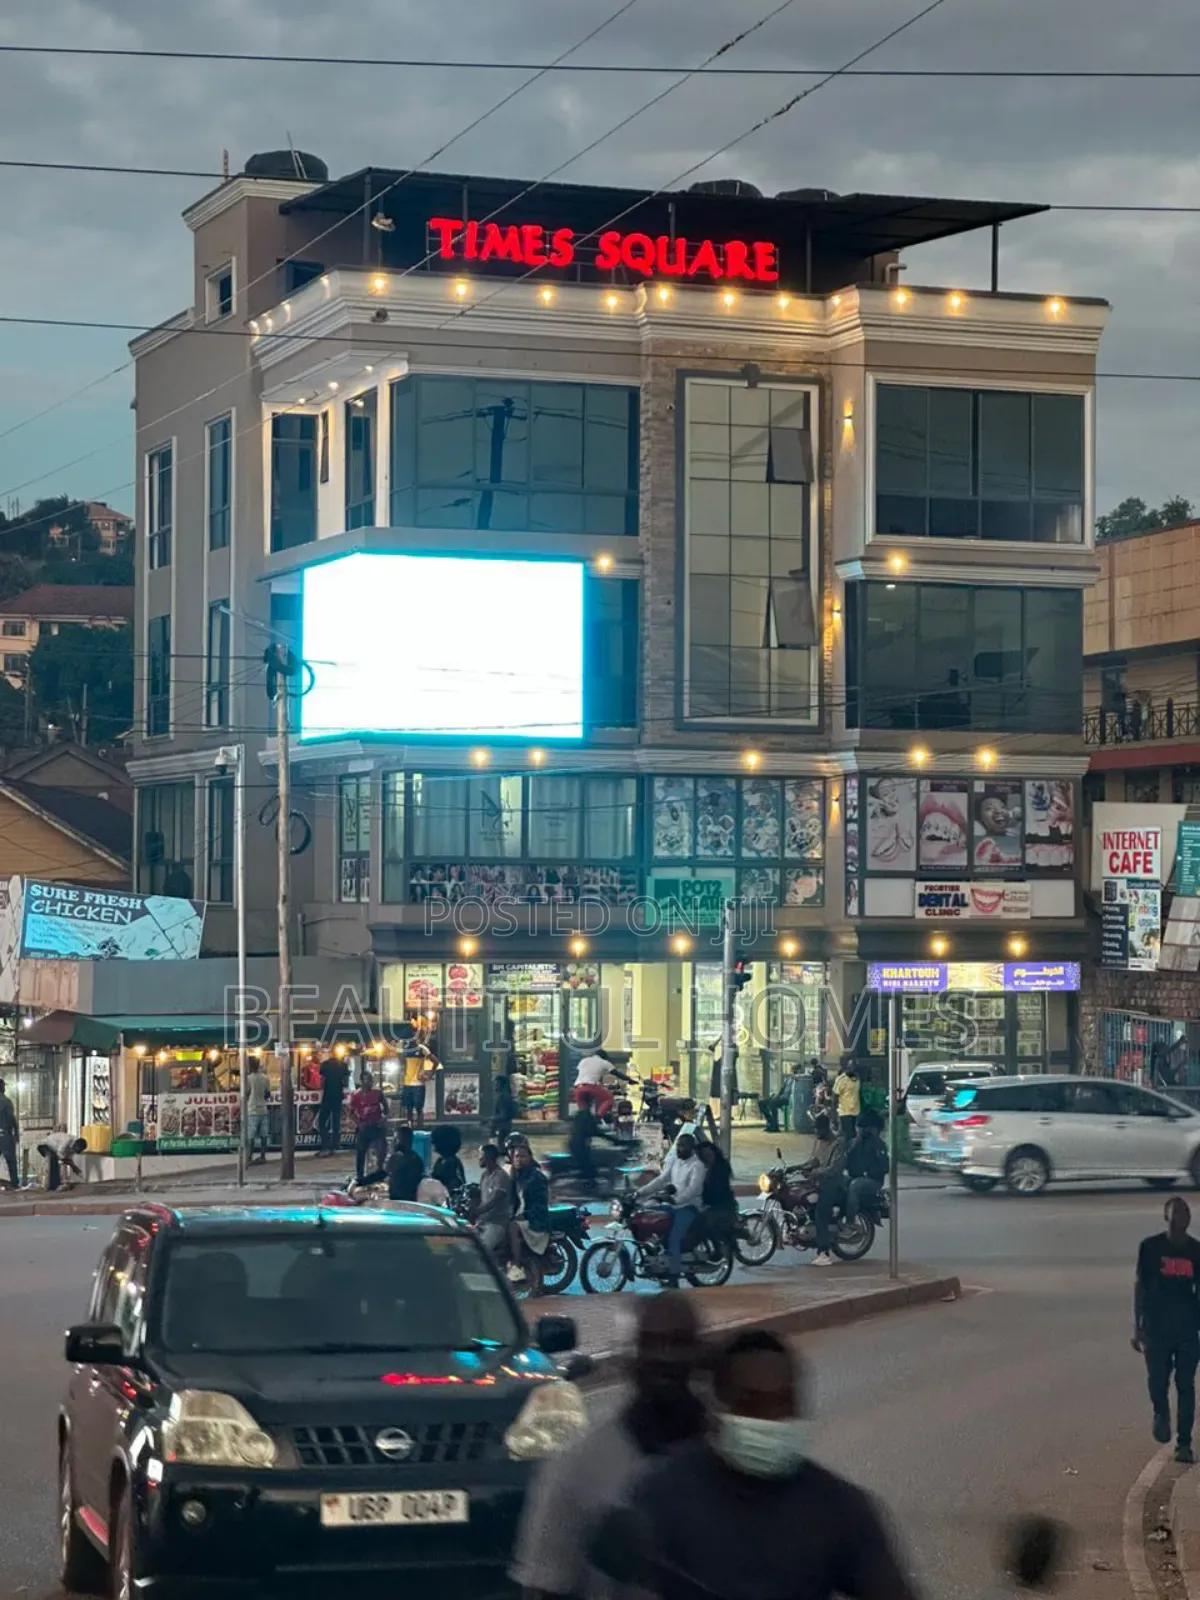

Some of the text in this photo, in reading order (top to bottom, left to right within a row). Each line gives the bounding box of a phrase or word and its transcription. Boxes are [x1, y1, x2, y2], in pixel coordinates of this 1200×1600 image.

[428, 218, 779, 281] TIMES SQUARE
[1102, 831, 1160, 850] INTERNET
[1109, 851, 1153, 874] CAFE
[30, 884, 143, 910] SURE FRESH
[918, 893, 969, 908] DENTAL
[31, 899, 133, 924] CHICKEN
[925, 908, 961, 916] CLINIC
[184, 1095, 238, 1105] JULIUS
